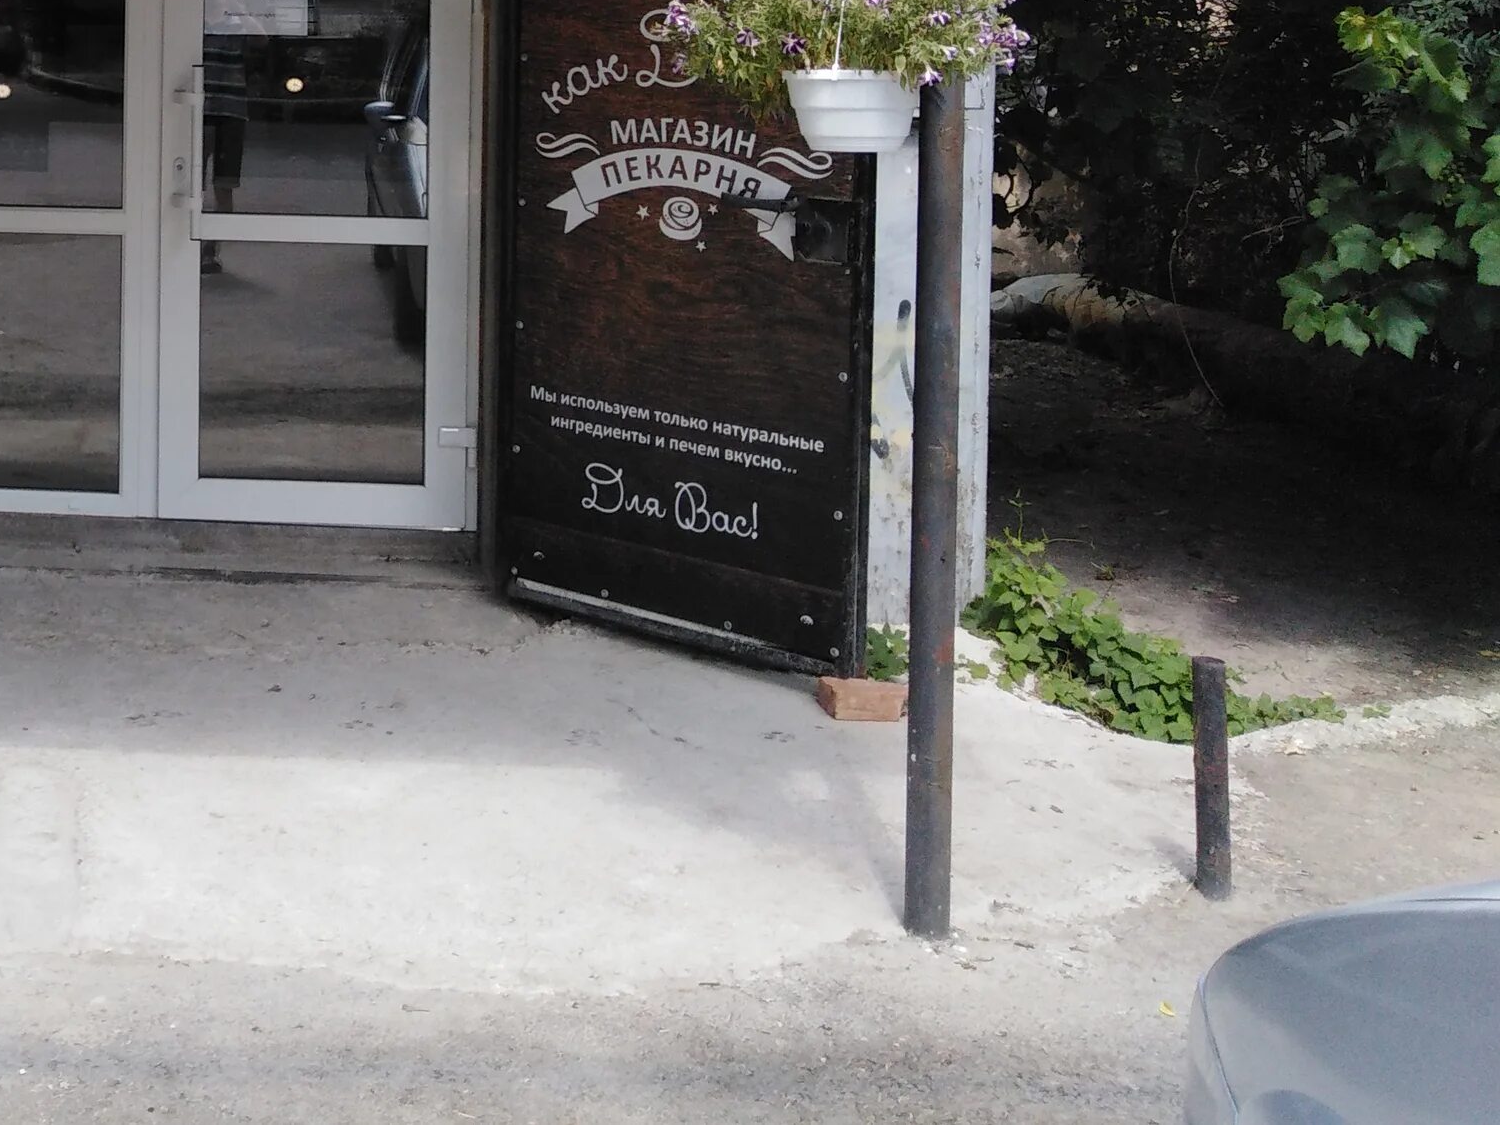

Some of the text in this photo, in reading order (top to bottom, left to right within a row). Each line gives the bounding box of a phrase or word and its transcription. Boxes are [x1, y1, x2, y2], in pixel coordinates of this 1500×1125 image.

[541, 53, 629, 114] как
[610, 118, 757, 159] МАГАЗИН
[600, 154, 762, 199] ПЕКАРНЯ
[530, 385, 825, 453] Мы используем только натуральные
[551, 415, 797, 475] ингредиенты и печем вкусно...
[581, 462, 758, 539] Для Вас!
